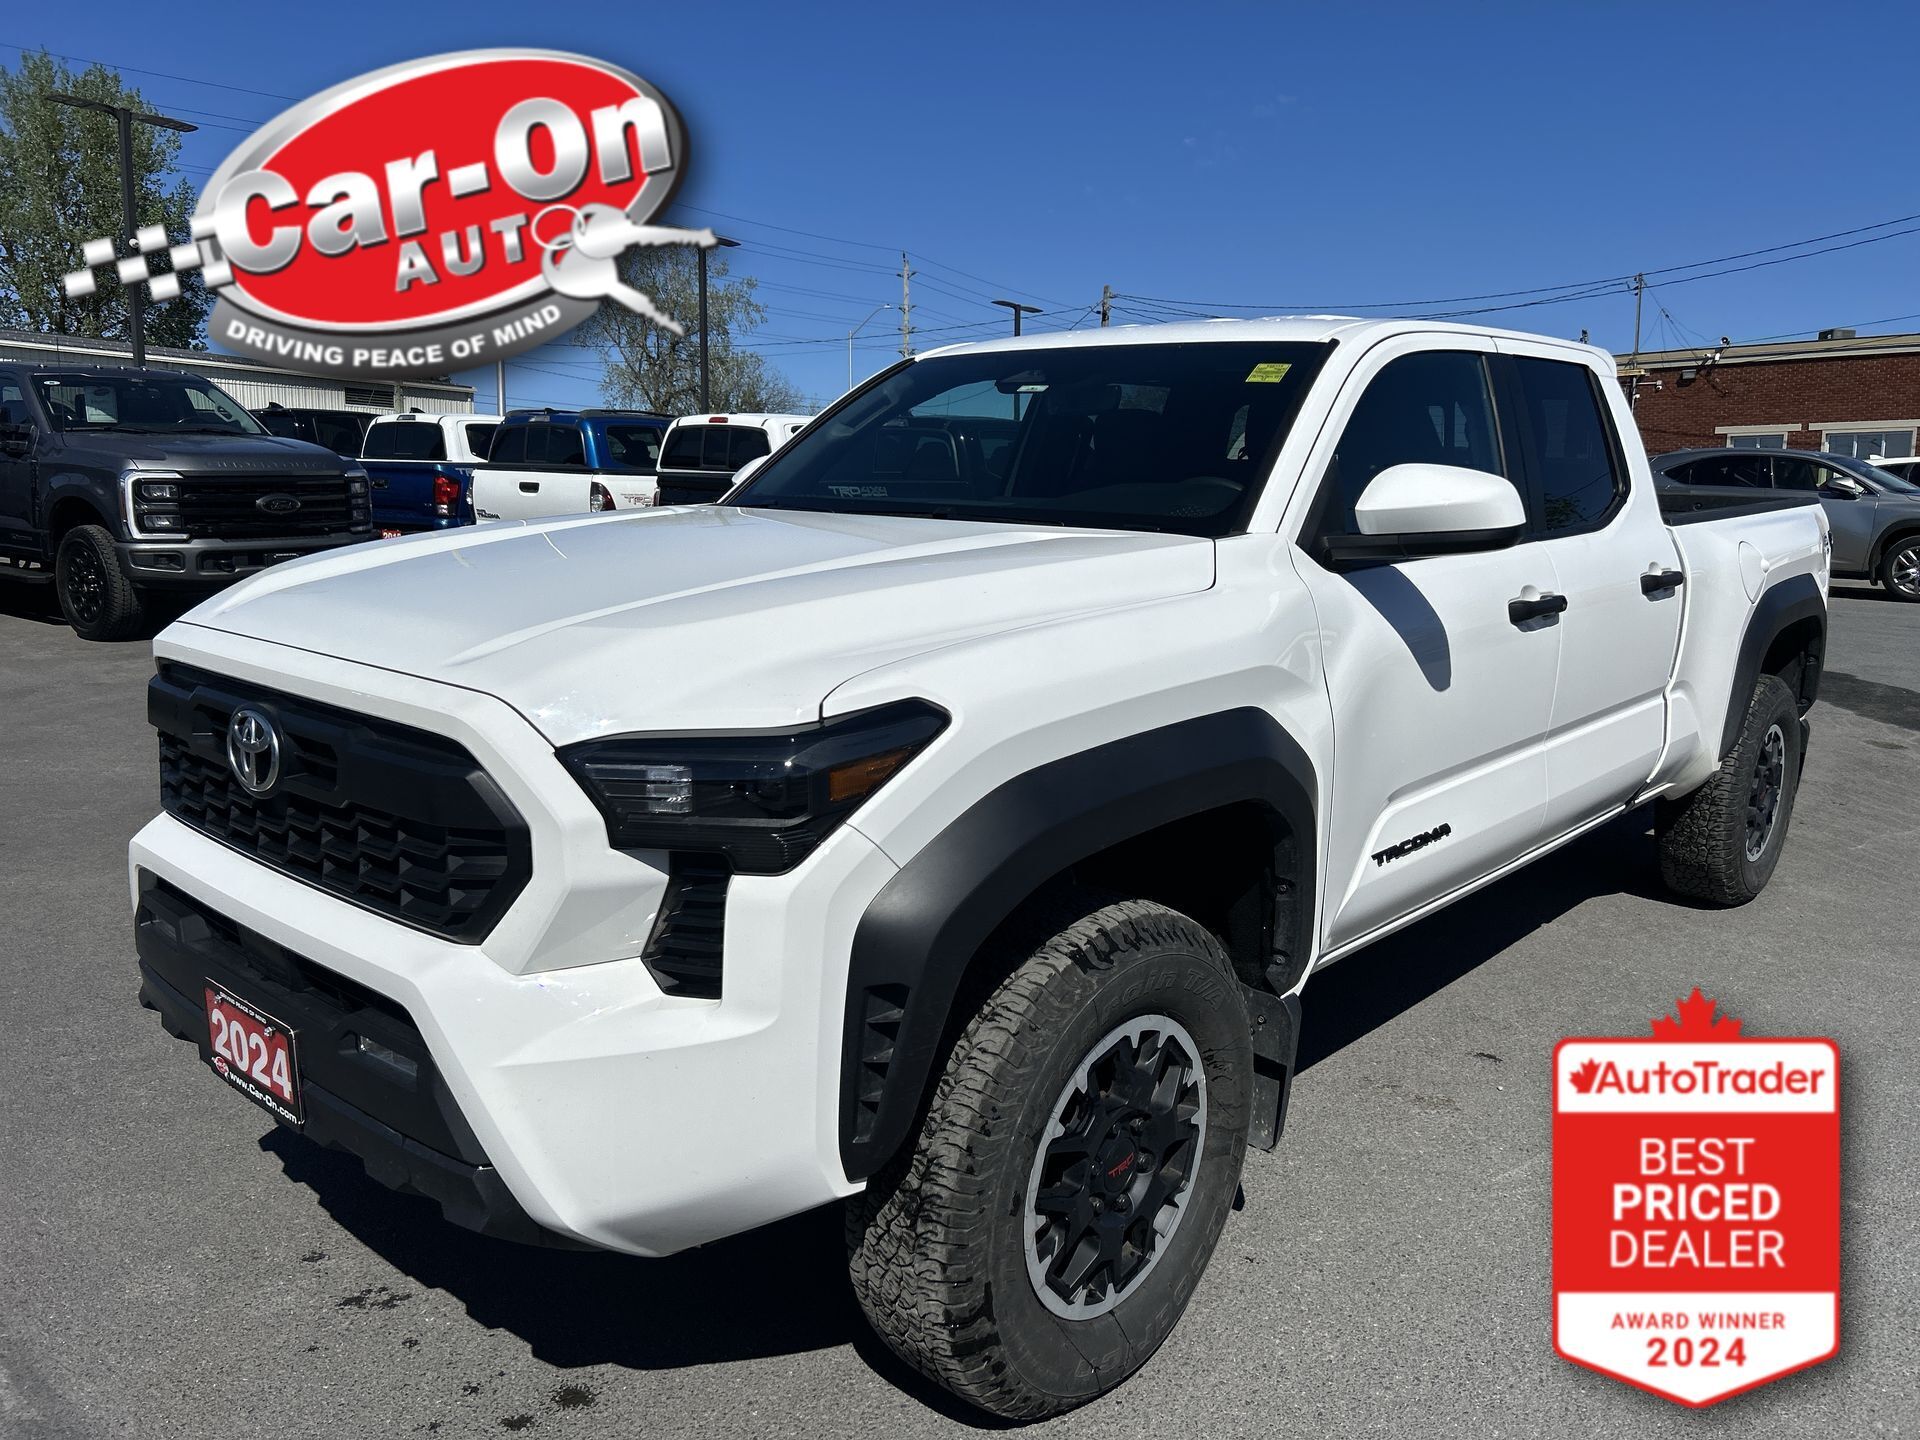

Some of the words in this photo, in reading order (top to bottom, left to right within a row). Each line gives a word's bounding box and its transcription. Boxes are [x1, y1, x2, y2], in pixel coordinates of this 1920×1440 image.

[1371, 822, 1452, 868] TACOMA
[211, 1008, 294, 1101] 2024
[229, 1071, 298, 1125] www.Car-On.com
[1108, 1151, 1134, 1178] TRD
